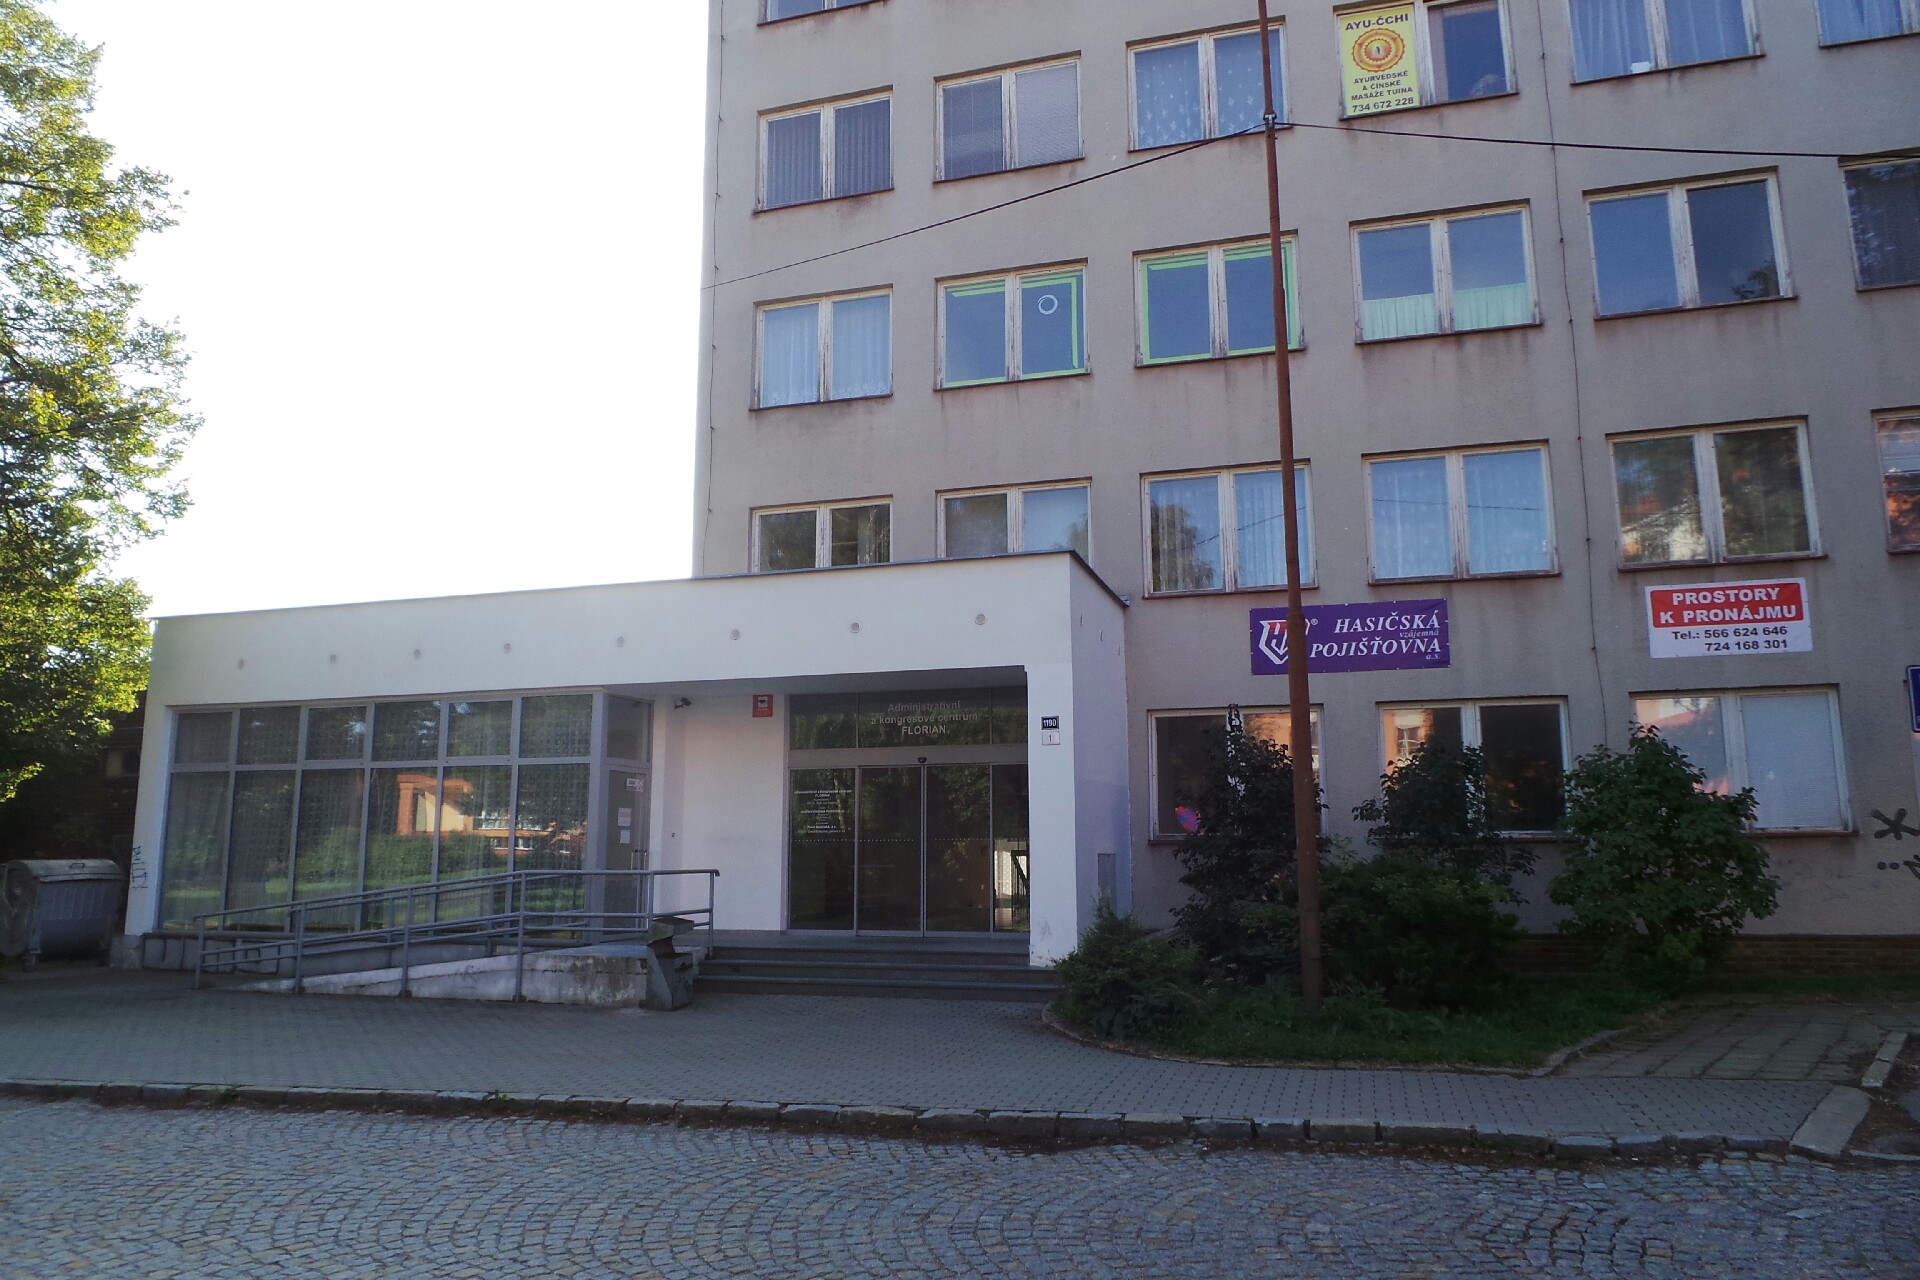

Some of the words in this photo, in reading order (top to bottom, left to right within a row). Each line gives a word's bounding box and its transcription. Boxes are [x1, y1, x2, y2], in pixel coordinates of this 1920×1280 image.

[1387, 87, 1413, 96] TUINA
[1352, 103, 1371, 113] 734
[1373, 100, 1392, 110] 672
[1395, 97, 1414, 107] 228
[1672, 587, 1781, 606] PROSTORY
[1334, 609, 1441, 634] HASIČSKÁ
[1660, 611, 1675, 624] K
[1683, 605, 1797, 623] PRONÁJMU
[1400, 629, 1440, 639] vzájemná
[1672, 631, 1700, 641] Tel.:
[1704, 629, 1729, 639] 566
[1733, 627, 1758, 637] 624
[1763, 625, 1788, 636] 646
[1310, 636, 1441, 658] POJIŠŤOVNA
[1705, 642, 1730, 652] 724
[1735, 640, 1760, 650] 168
[1764, 639, 1788, 649] 301
[887, 700, 961, 713] Administrativní
[880, 714, 935, 726] kongresové
[938, 712, 978, 722] centrum
[1043, 718, 1057, 727] 1190
[901, 724, 946, 735] FLORIAN
